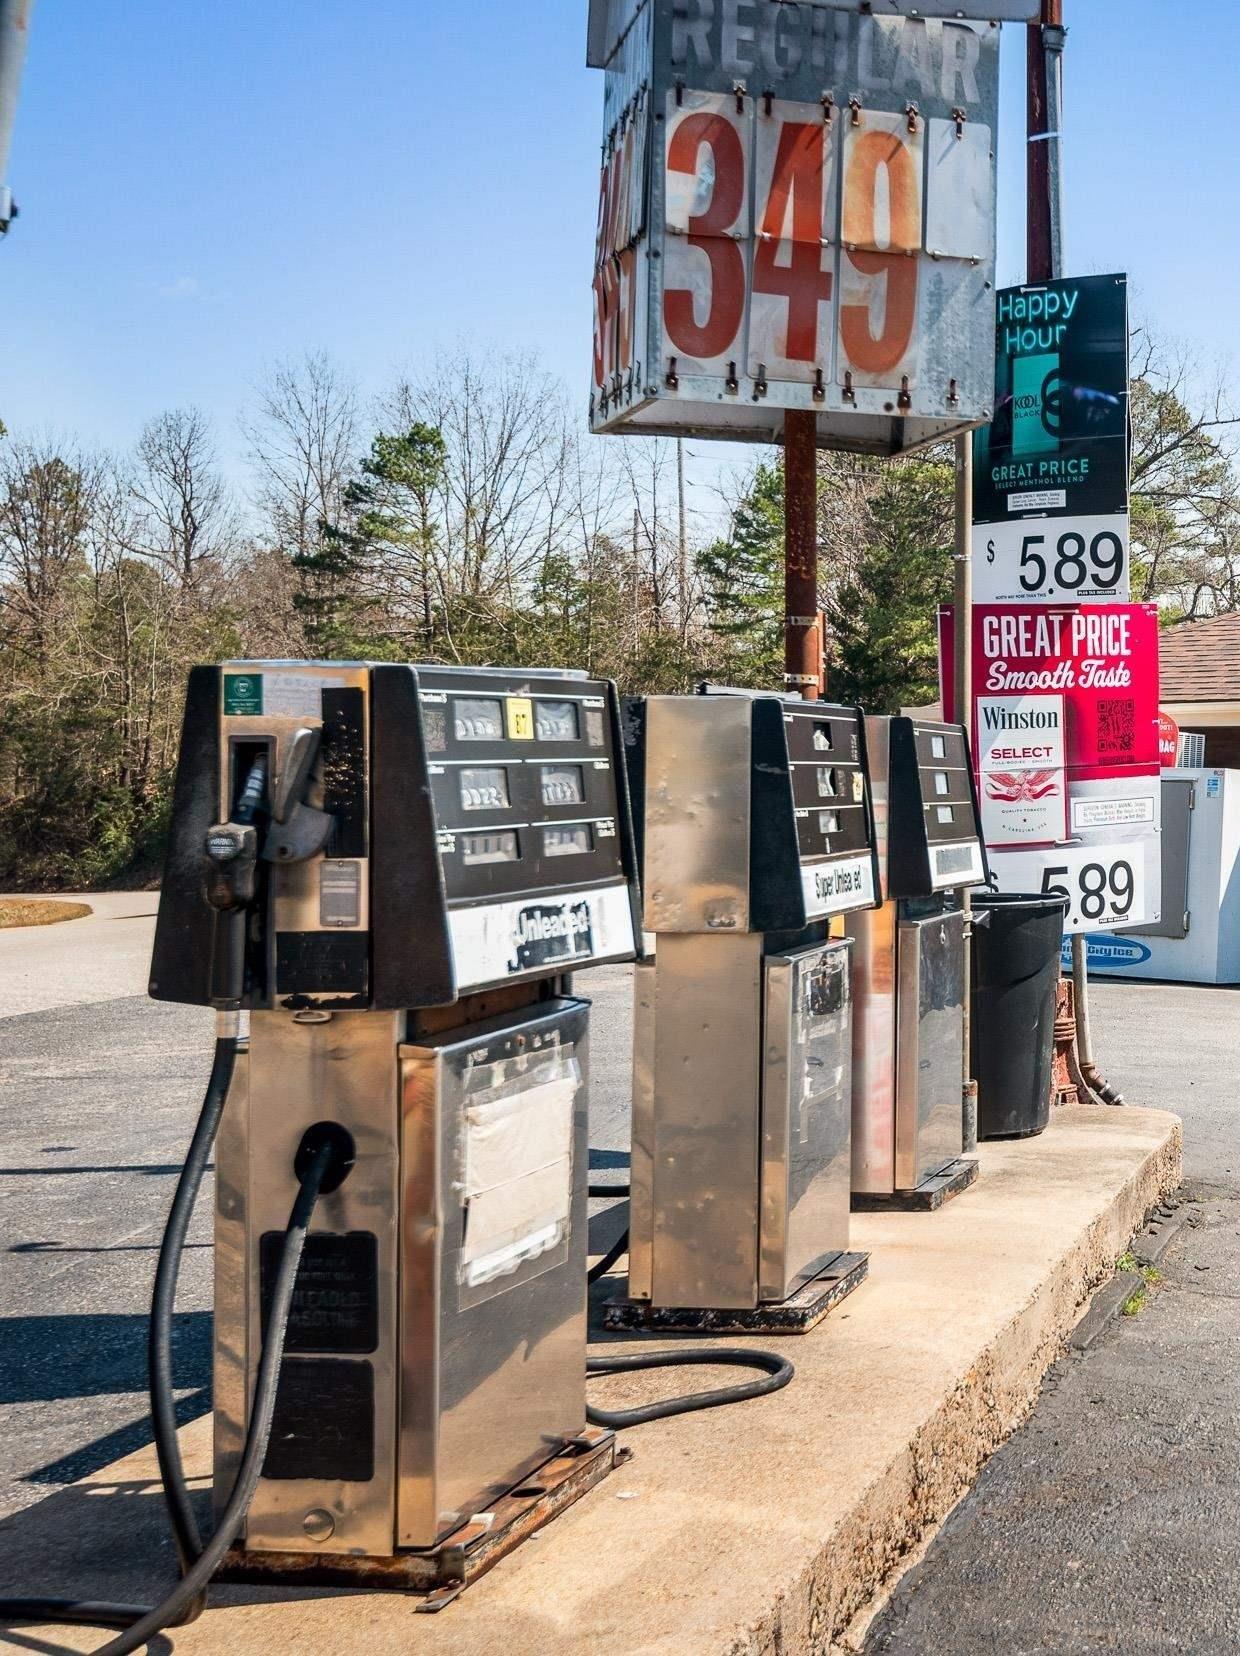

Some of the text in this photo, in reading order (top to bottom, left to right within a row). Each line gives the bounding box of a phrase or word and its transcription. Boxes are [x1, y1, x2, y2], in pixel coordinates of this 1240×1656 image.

[671, 2, 981, 103] REGULAR
[663, 112, 920, 373] 349
[999, 290, 1078, 322] Happy
[1006, 324, 1067, 354] Hour
[1014, 394, 1040, 409] KOOL
[1014, 410, 1040, 419] BLACK
[991, 458, 1089, 481] GREAT PRICE
[995, 475, 1084, 489] SELECT MENTHOL BLEND
[986, 531, 1124, 593] $ 5.89
[983, 614, 1132, 658] GREAT PRICE
[985, 659, 1132, 691] Smooth Taste
[982, 706, 1058, 730] Winston
[990, 747, 1053, 759] SELECT
[815, 864, 862, 904] Super Unleaed
[1088, 946, 1133, 956] City Ice
